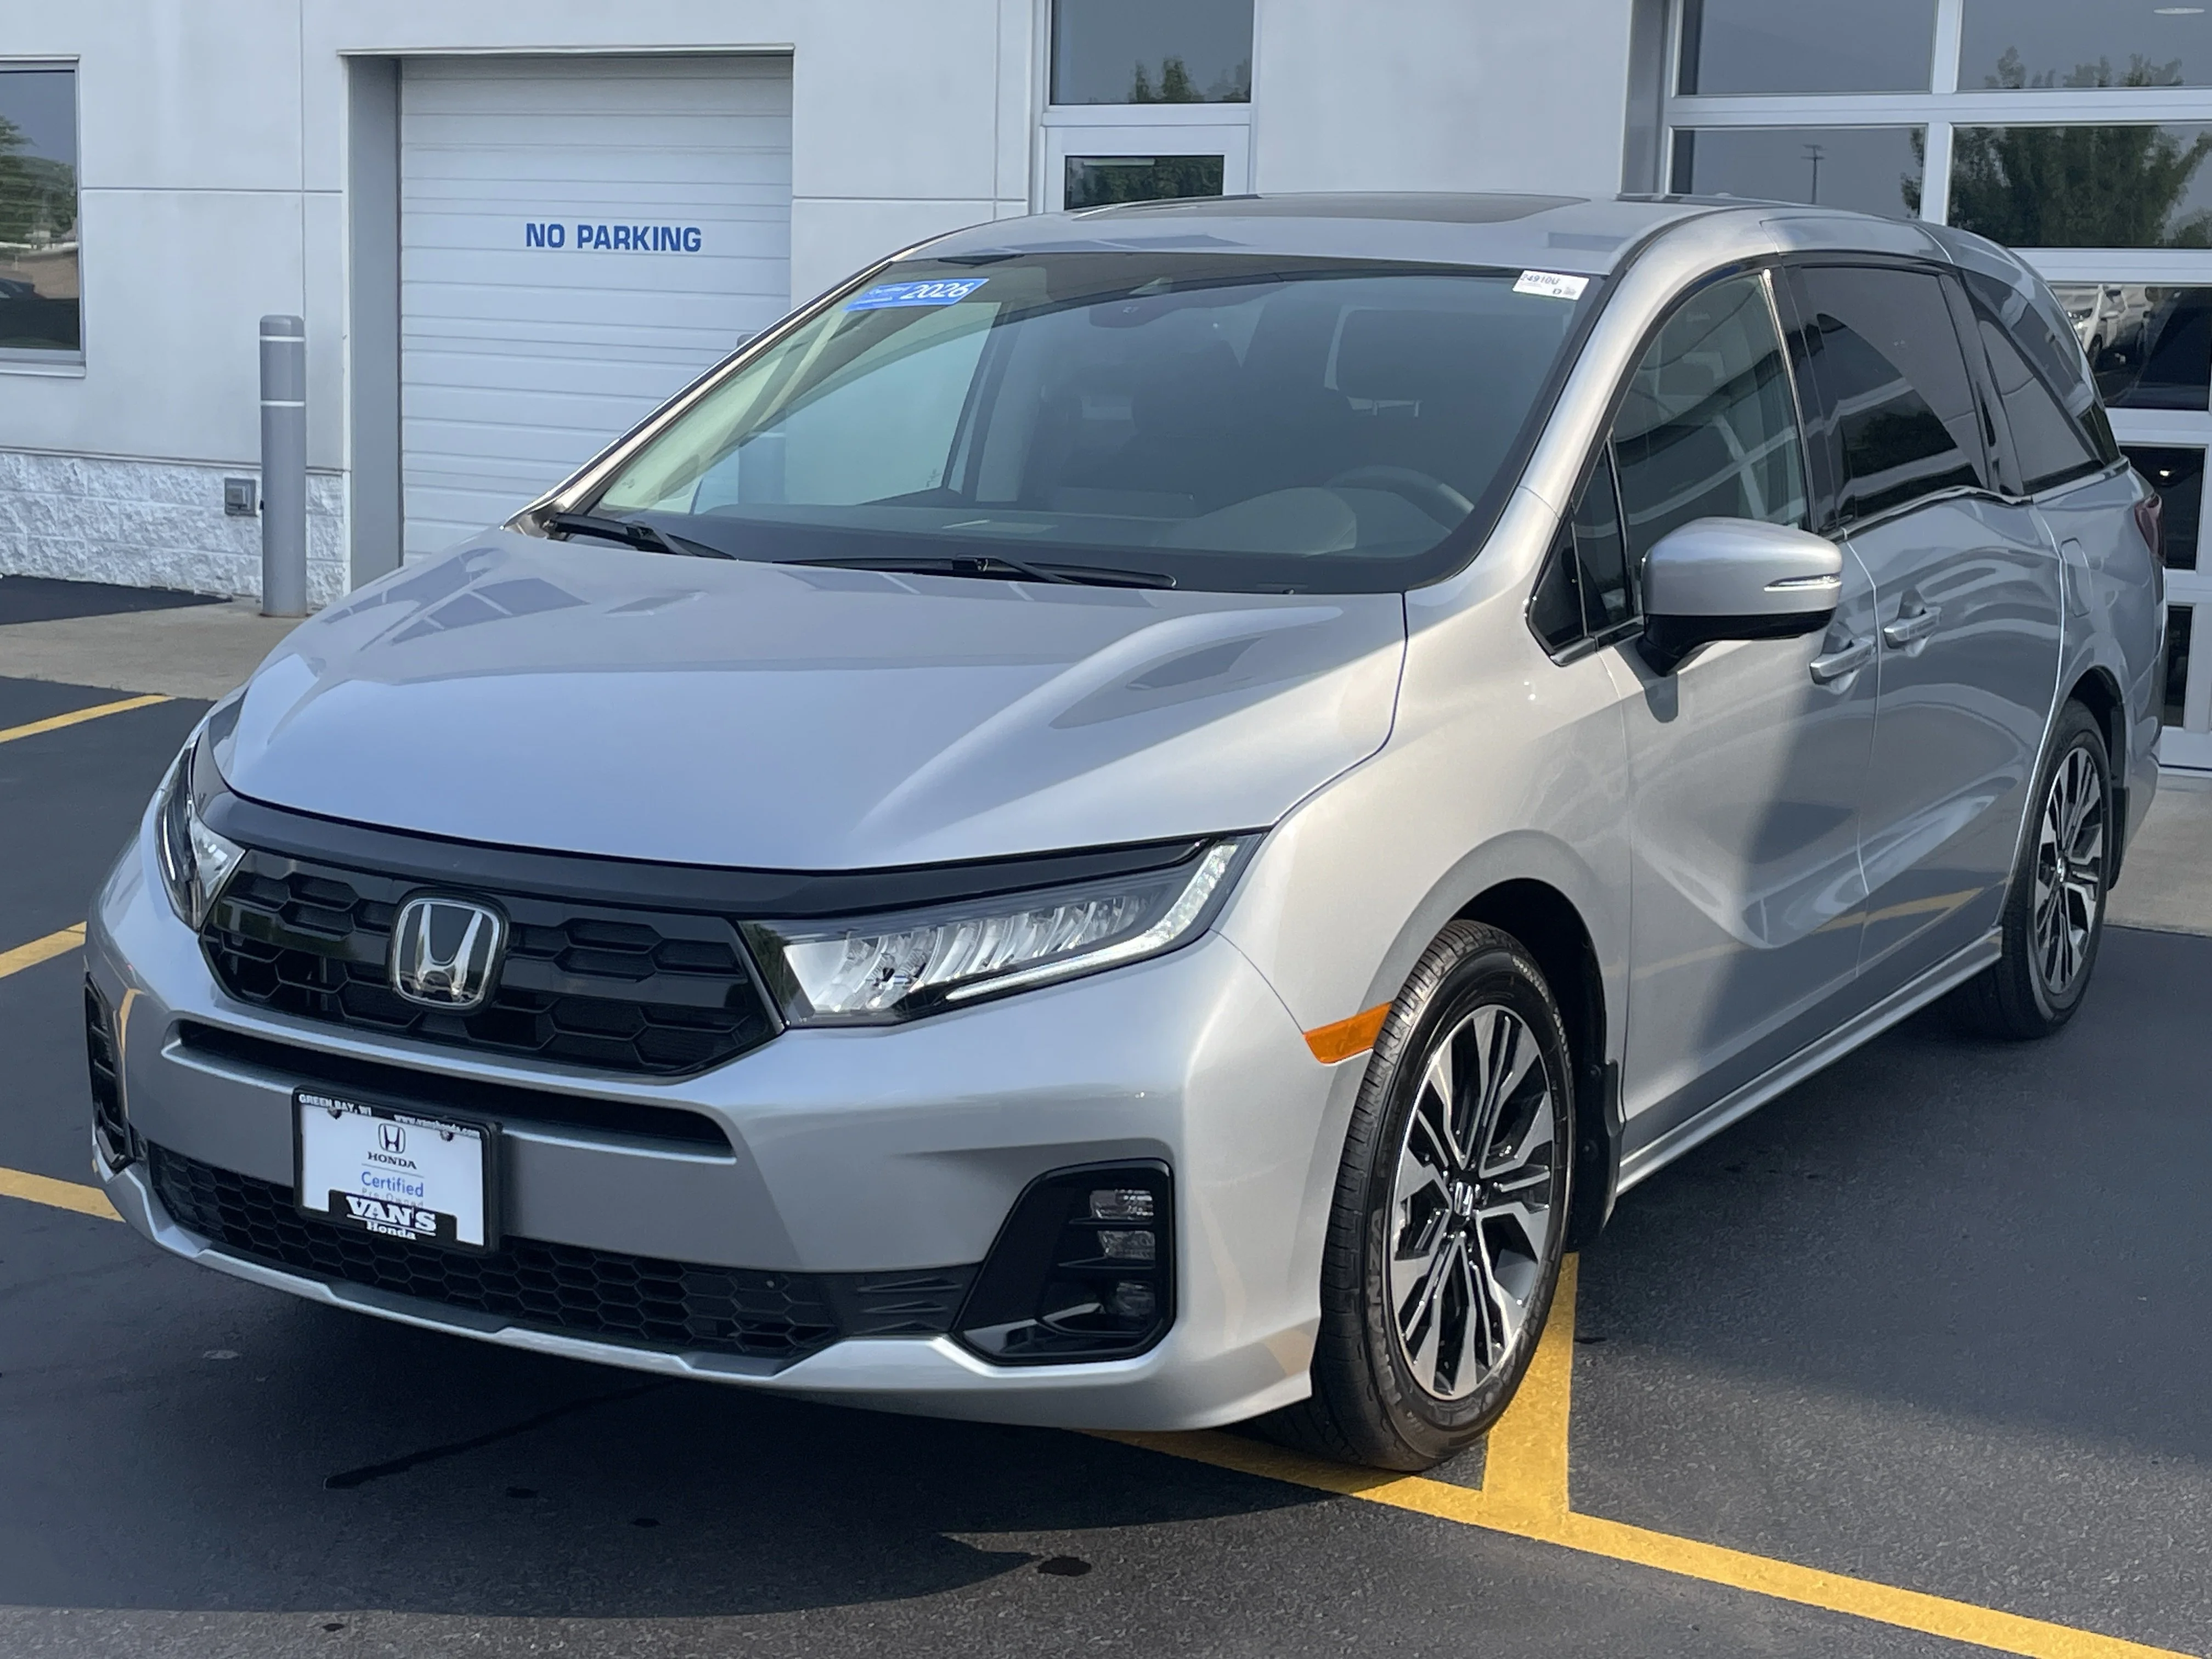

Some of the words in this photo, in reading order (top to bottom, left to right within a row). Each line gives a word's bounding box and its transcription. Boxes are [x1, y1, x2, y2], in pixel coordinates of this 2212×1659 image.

[526, 223, 565, 247] NO
[577, 224, 702, 252] PARKING
[1520, 273, 1561, 285] 24910U
[899, 283, 975, 300] 2026
[358, 1104, 372, 1116] WI
[367, 1151, 417, 1170] HONDA
[361, 1171, 424, 1198] Certified
[366, 1221, 417, 1241] Honda
